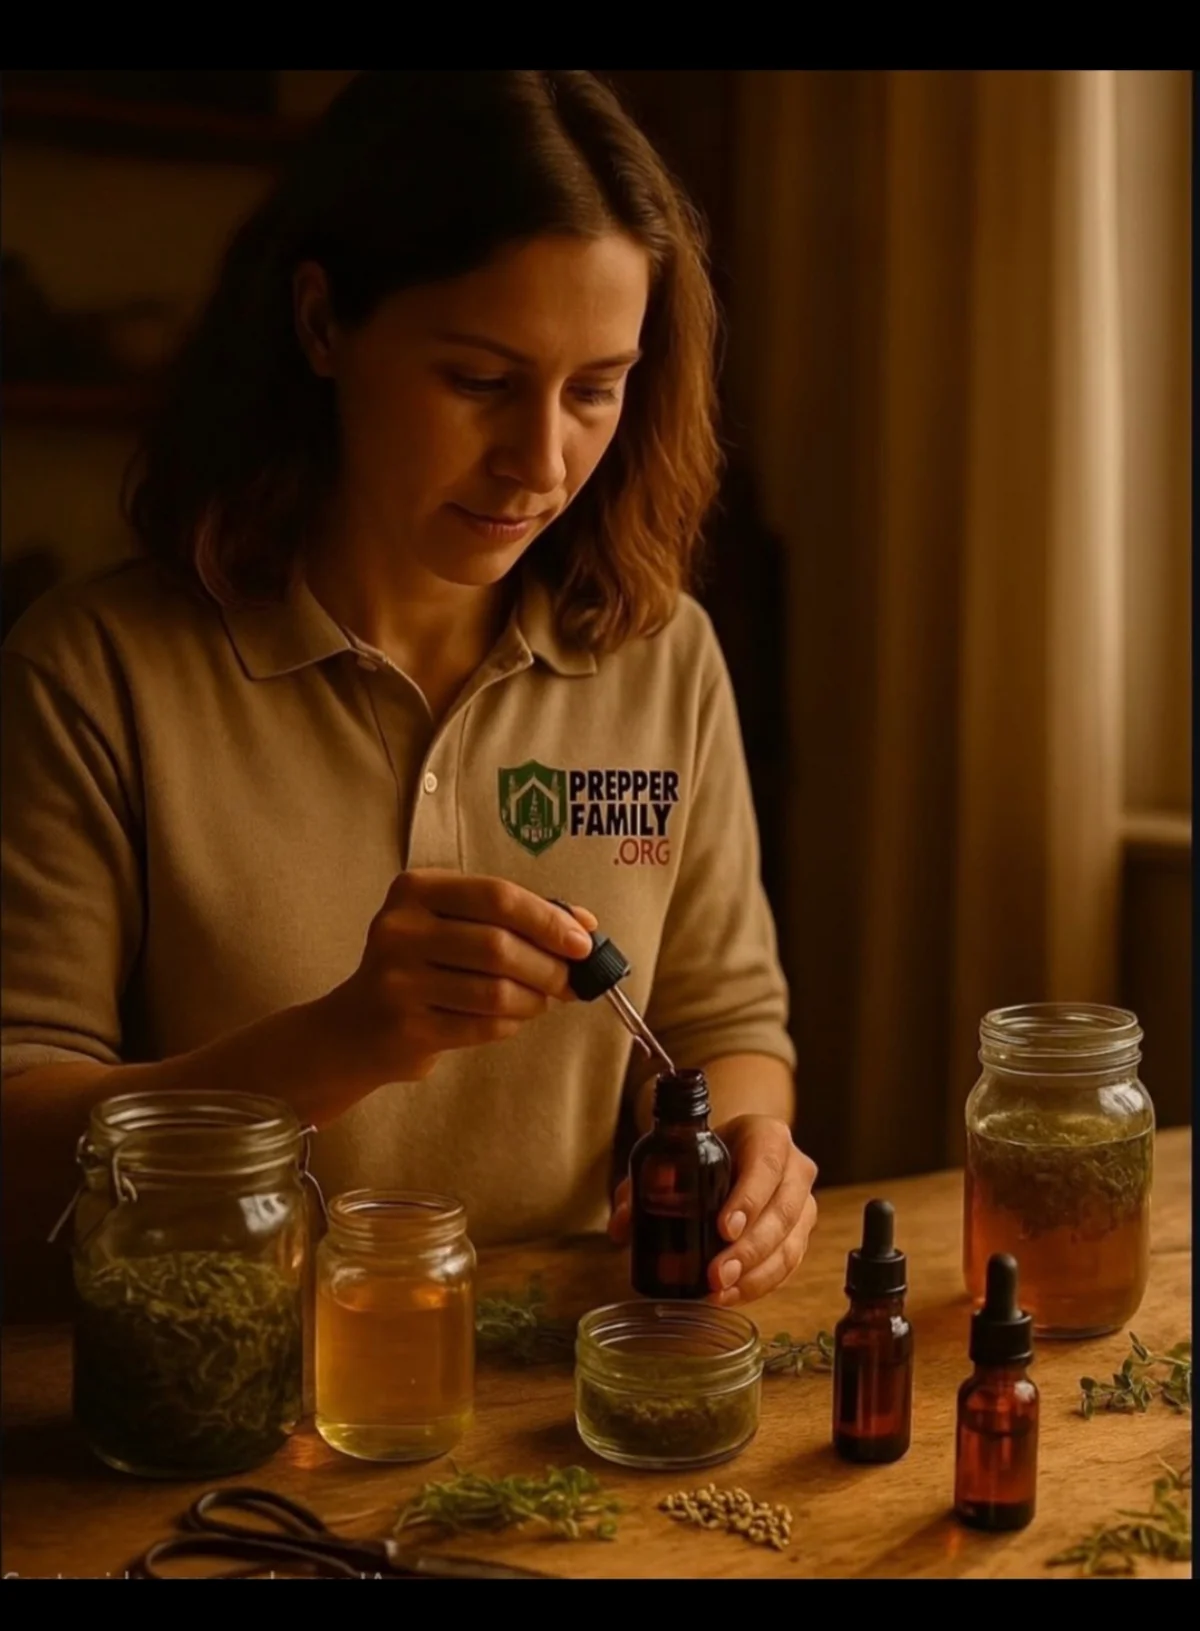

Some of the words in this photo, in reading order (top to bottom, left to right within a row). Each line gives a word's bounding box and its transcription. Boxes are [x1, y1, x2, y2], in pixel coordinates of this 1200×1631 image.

[569, 770, 679, 802] PREPPER
[570, 803, 672, 836] FAMILY
[613, 838, 671, 866] .ORG
